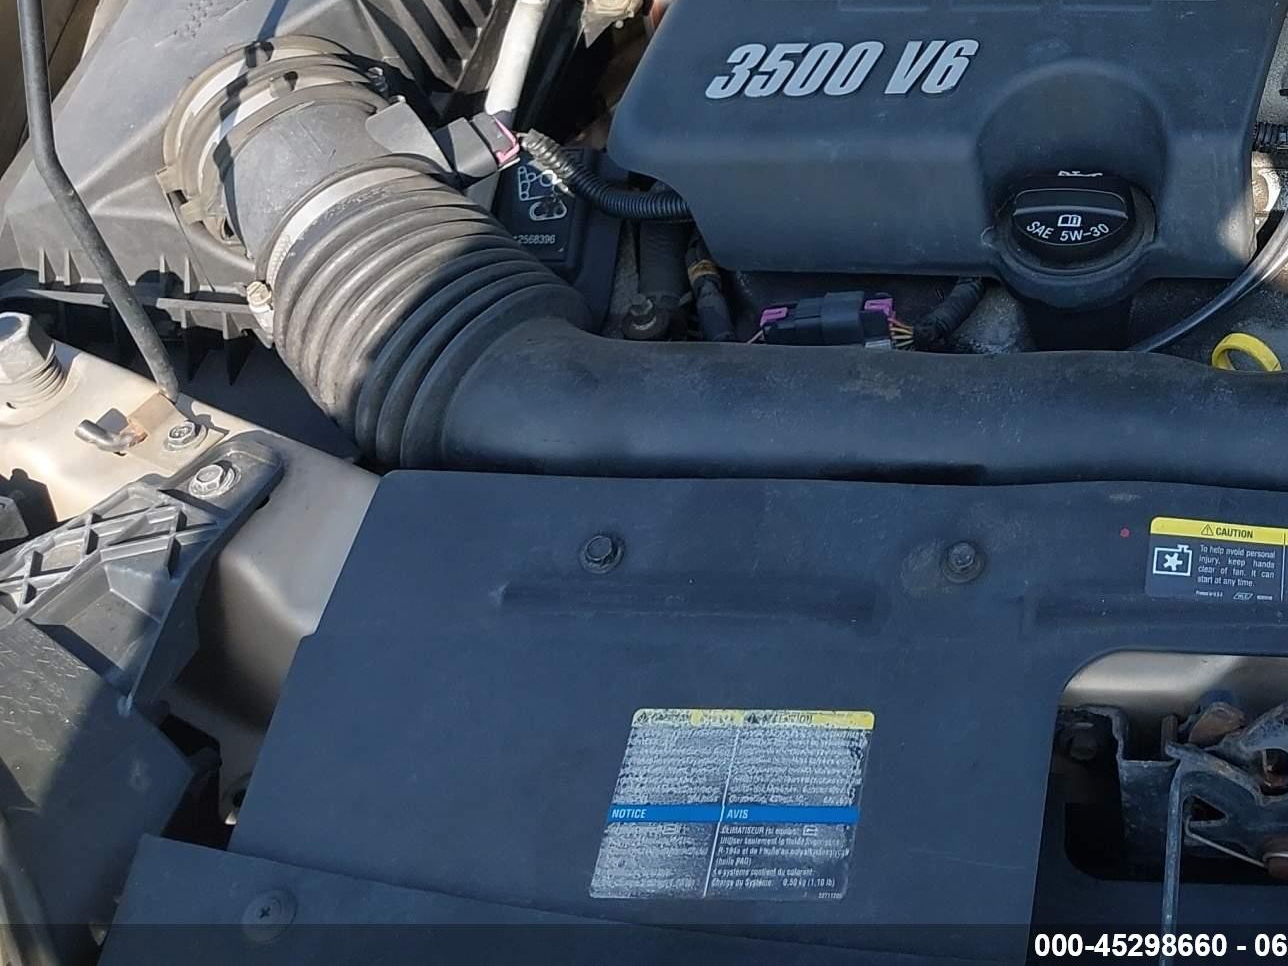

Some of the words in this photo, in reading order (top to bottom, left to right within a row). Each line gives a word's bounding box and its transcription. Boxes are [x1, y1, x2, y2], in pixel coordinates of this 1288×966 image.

[705, 41, 884, 99] 3500
[884, 39, 979, 95] V6
[1026, 221, 1055, 240] SAE
[1059, 223, 1110, 242] 5W-30
[513, 234, 556, 244] 2568396
[1215, 527, 1254, 539] CAUTION
[1200, 544, 1208, 553] To
[1209, 545, 1224, 555] help
[1225, 547, 1244, 556] avoid
[1245, 549, 1276, 559] personal
[1227, 557, 1246, 567] keep
[1252, 559, 1275, 569] hands
[1197, 565, 1215, 573] clear
[1220, 566, 1228, 575] of
[1261, 571, 1275, 579] can
[1197, 575, 1213, 584] start
[1222, 578, 1236, 587] any
[611, 808, 647, 819] NOTICE
[726, 808, 749, 819] AVIS
[750, 868, 777, 877] contient
[777, 868, 786, 877] du
